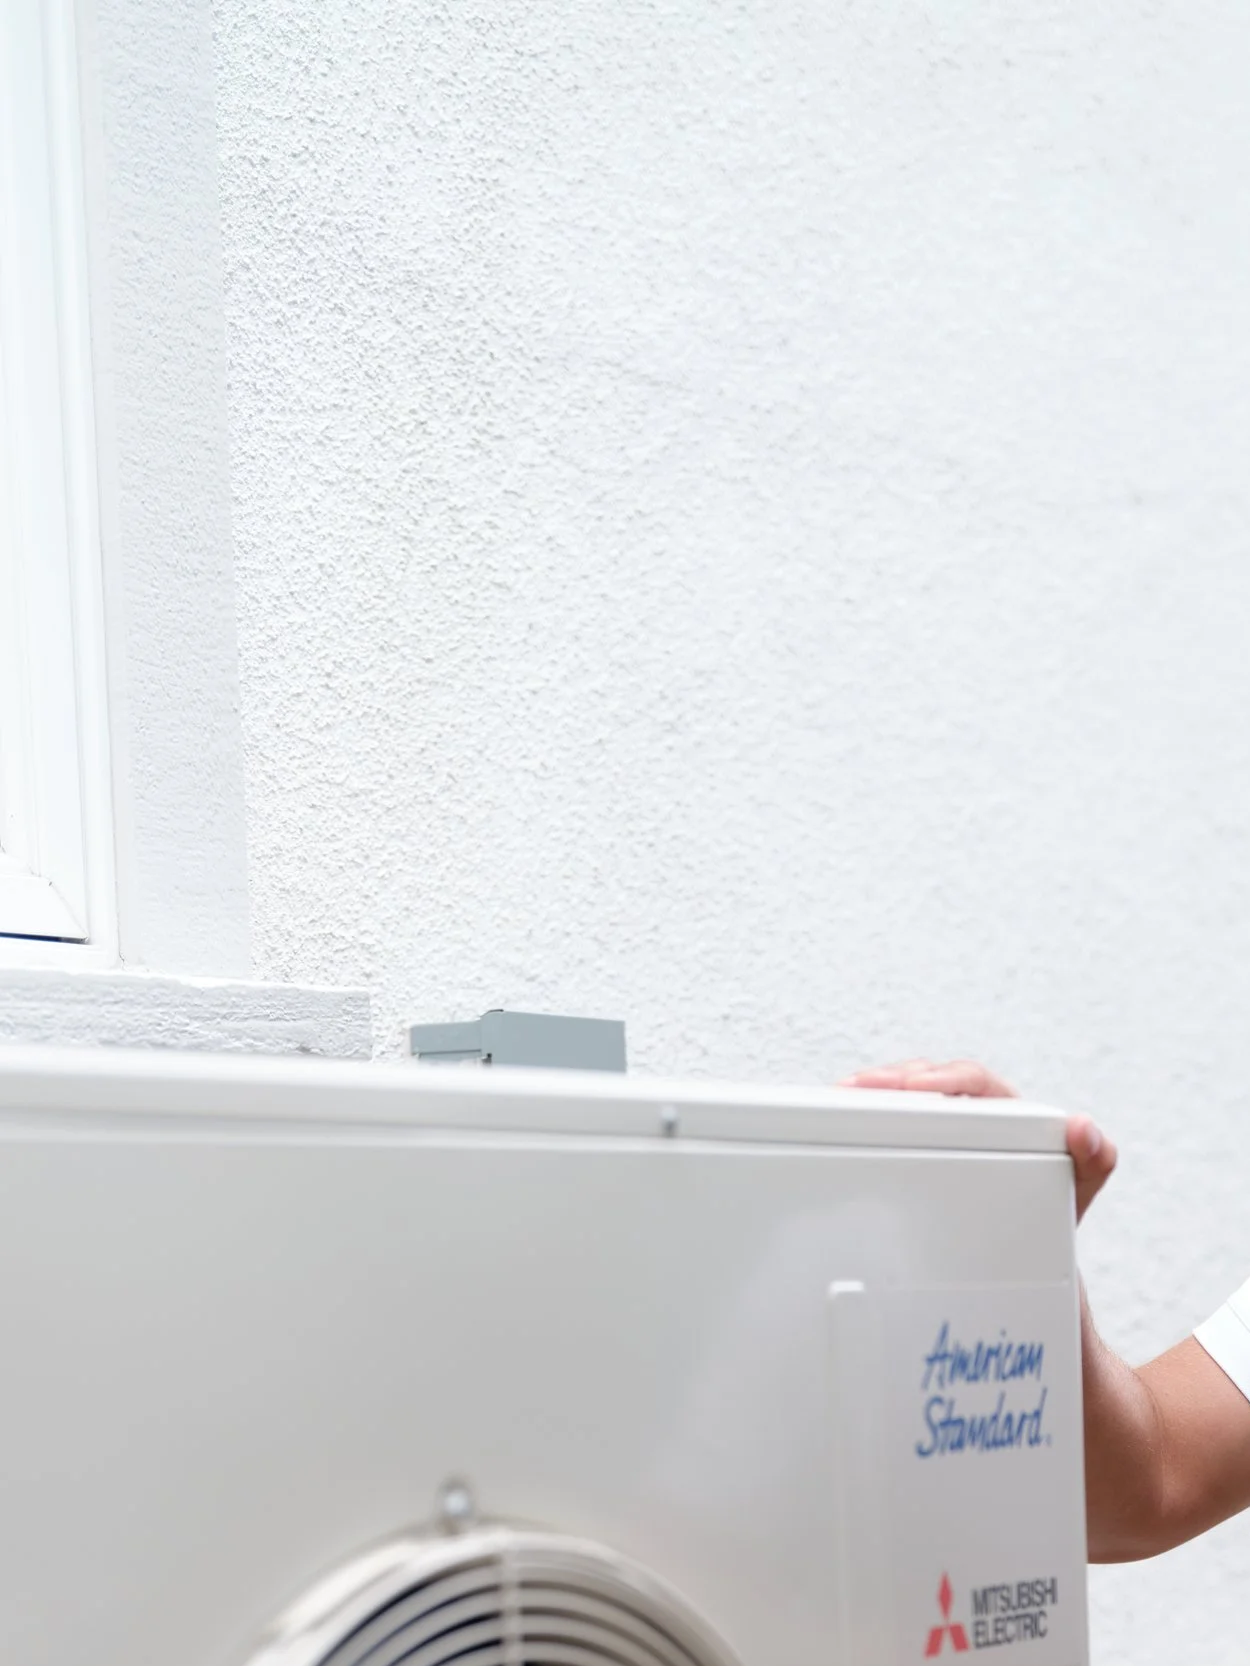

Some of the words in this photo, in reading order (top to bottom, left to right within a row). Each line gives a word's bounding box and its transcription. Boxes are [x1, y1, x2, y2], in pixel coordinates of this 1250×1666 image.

[922, 1321, 1044, 1391] American
[971, 1577, 1058, 1616] MITSUBISHI
[972, 1610, 1048, 1649] ELECTRIC
